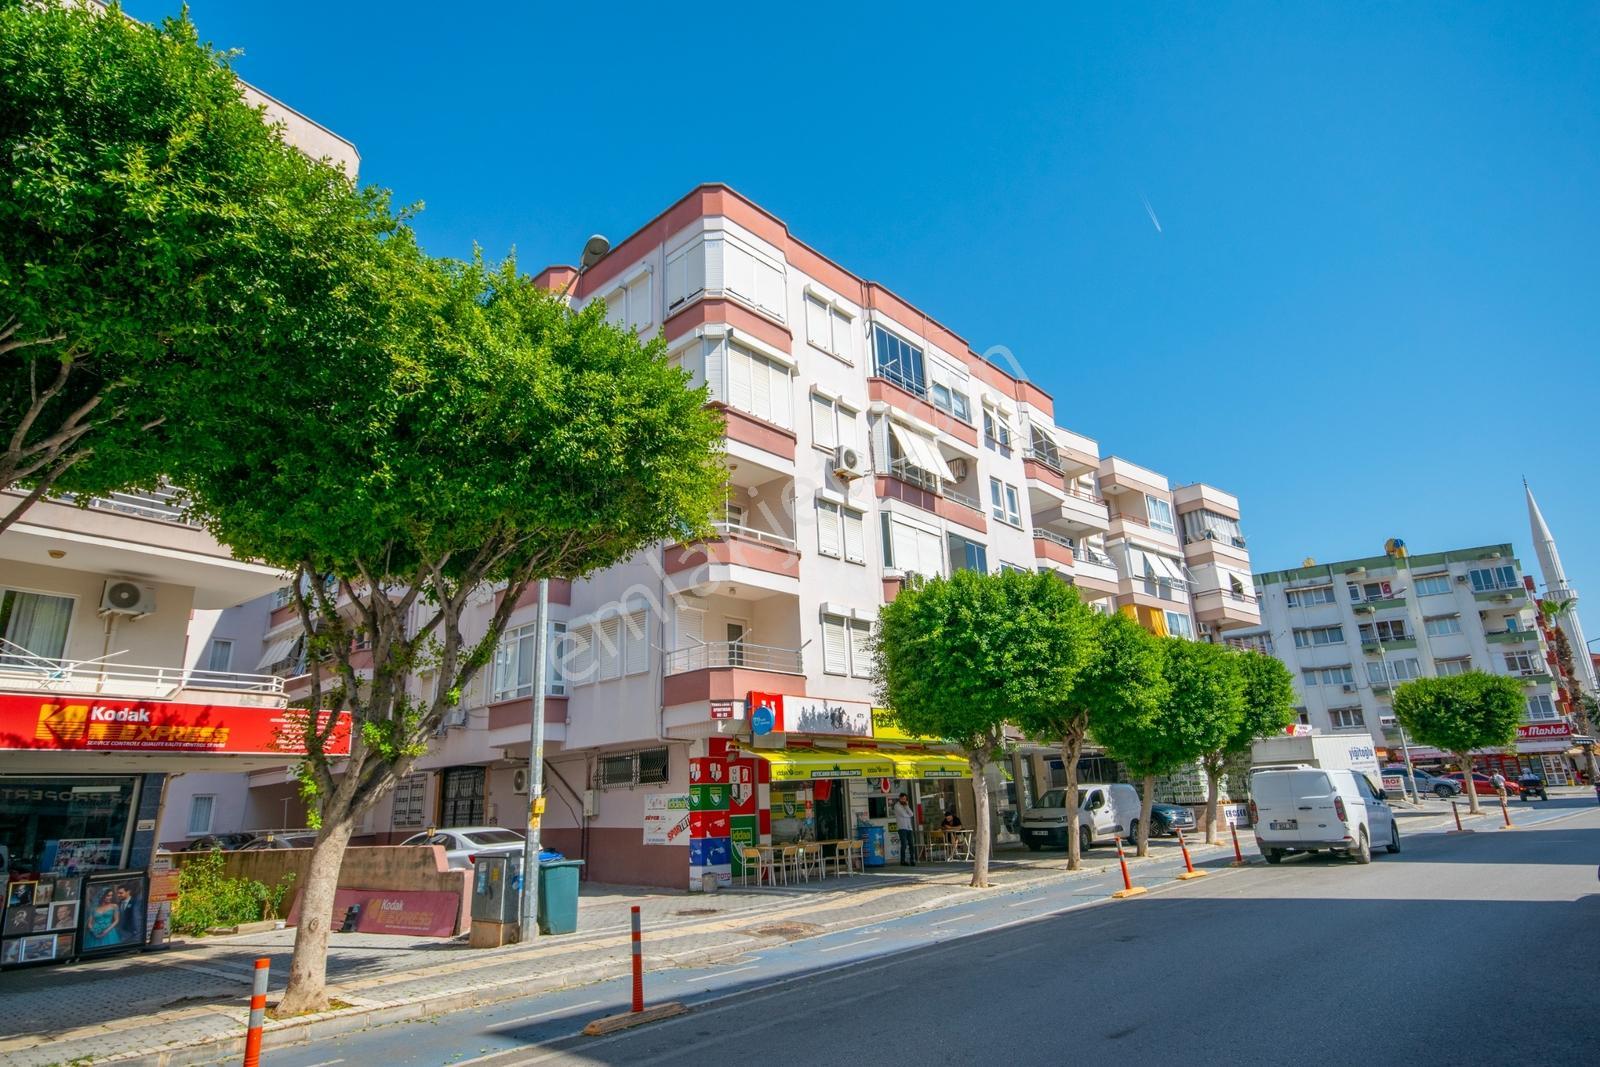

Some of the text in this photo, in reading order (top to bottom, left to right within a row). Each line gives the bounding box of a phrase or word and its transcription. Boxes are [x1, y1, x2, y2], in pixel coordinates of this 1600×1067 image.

[91, 706, 149, 722] Kodak
[120, 725, 230, 742] EXPRESS
[1526, 722, 1567, 736] Market
[381, 899, 403, 911] Kodak
